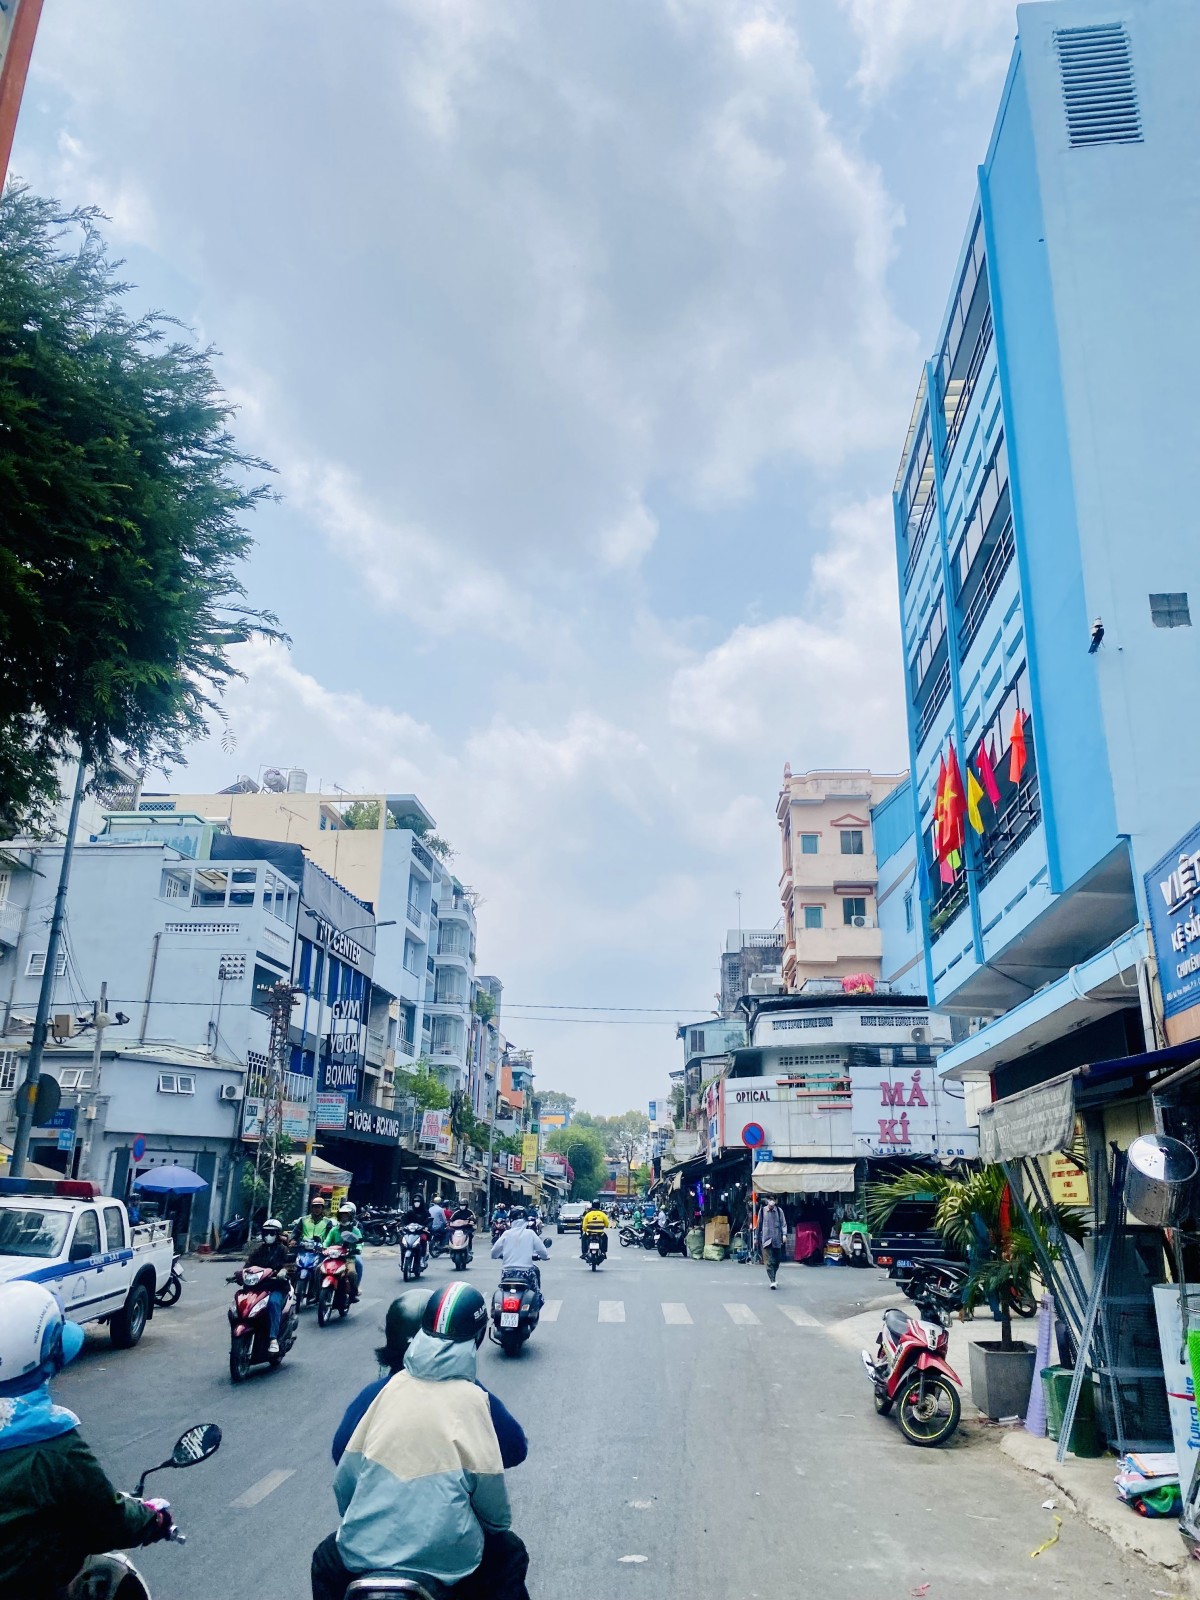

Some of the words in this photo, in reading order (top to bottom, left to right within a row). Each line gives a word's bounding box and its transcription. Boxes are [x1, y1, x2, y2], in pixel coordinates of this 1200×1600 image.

[333, 929, 361, 966] CENTER
[332, 1000, 360, 1019] GYM
[330, 1033, 358, 1054] YOGA
[325, 1064, 357, 1086] BOXING
[736, 1090, 770, 1103] OPTICAL
[376, 1115, 399, 1138] BOXING
[426, 1113, 439, 1124] GIA
